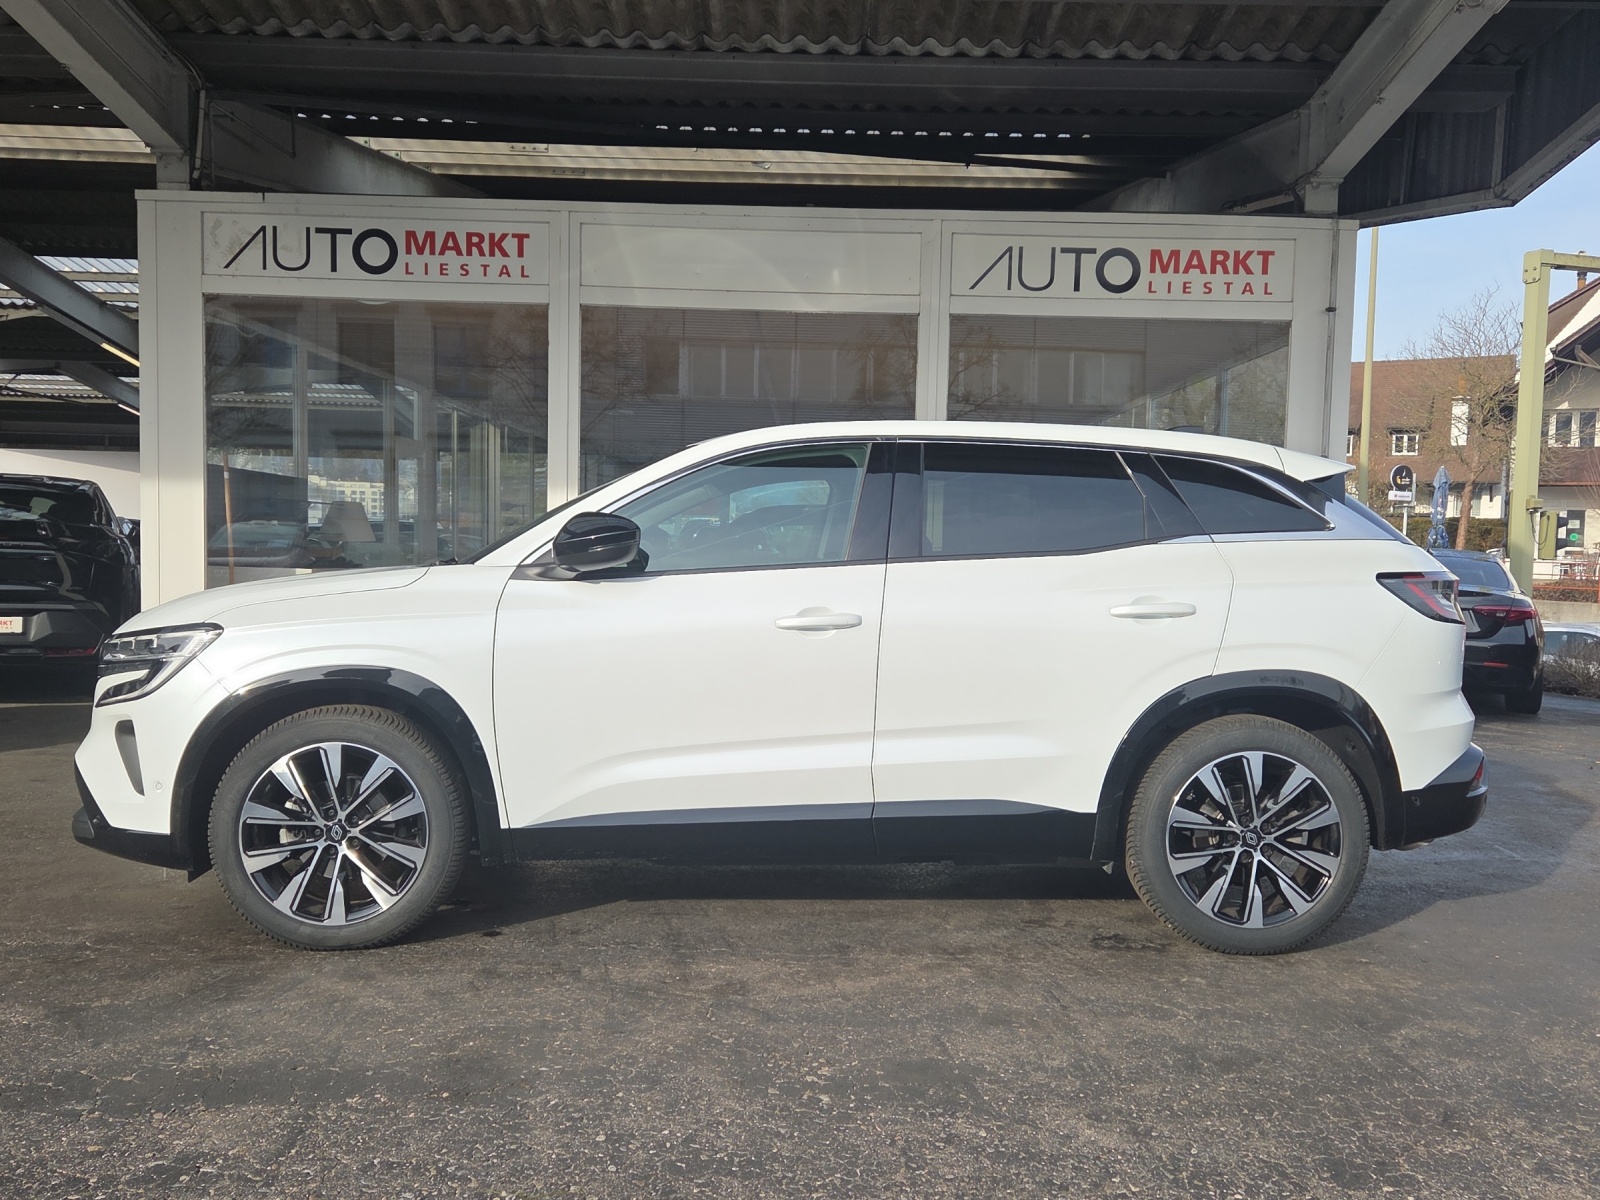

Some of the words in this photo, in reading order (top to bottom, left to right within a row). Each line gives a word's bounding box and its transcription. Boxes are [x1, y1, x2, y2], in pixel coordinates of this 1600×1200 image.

[223, 225, 399, 275] AUTO
[405, 230, 530, 258] MARKT
[405, 262, 530, 278] LIESTAL
[968, 245, 1142, 294] AUTO
[1149, 249, 1275, 276] MARKT
[1148, 281, 1273, 295] LIESTAL
